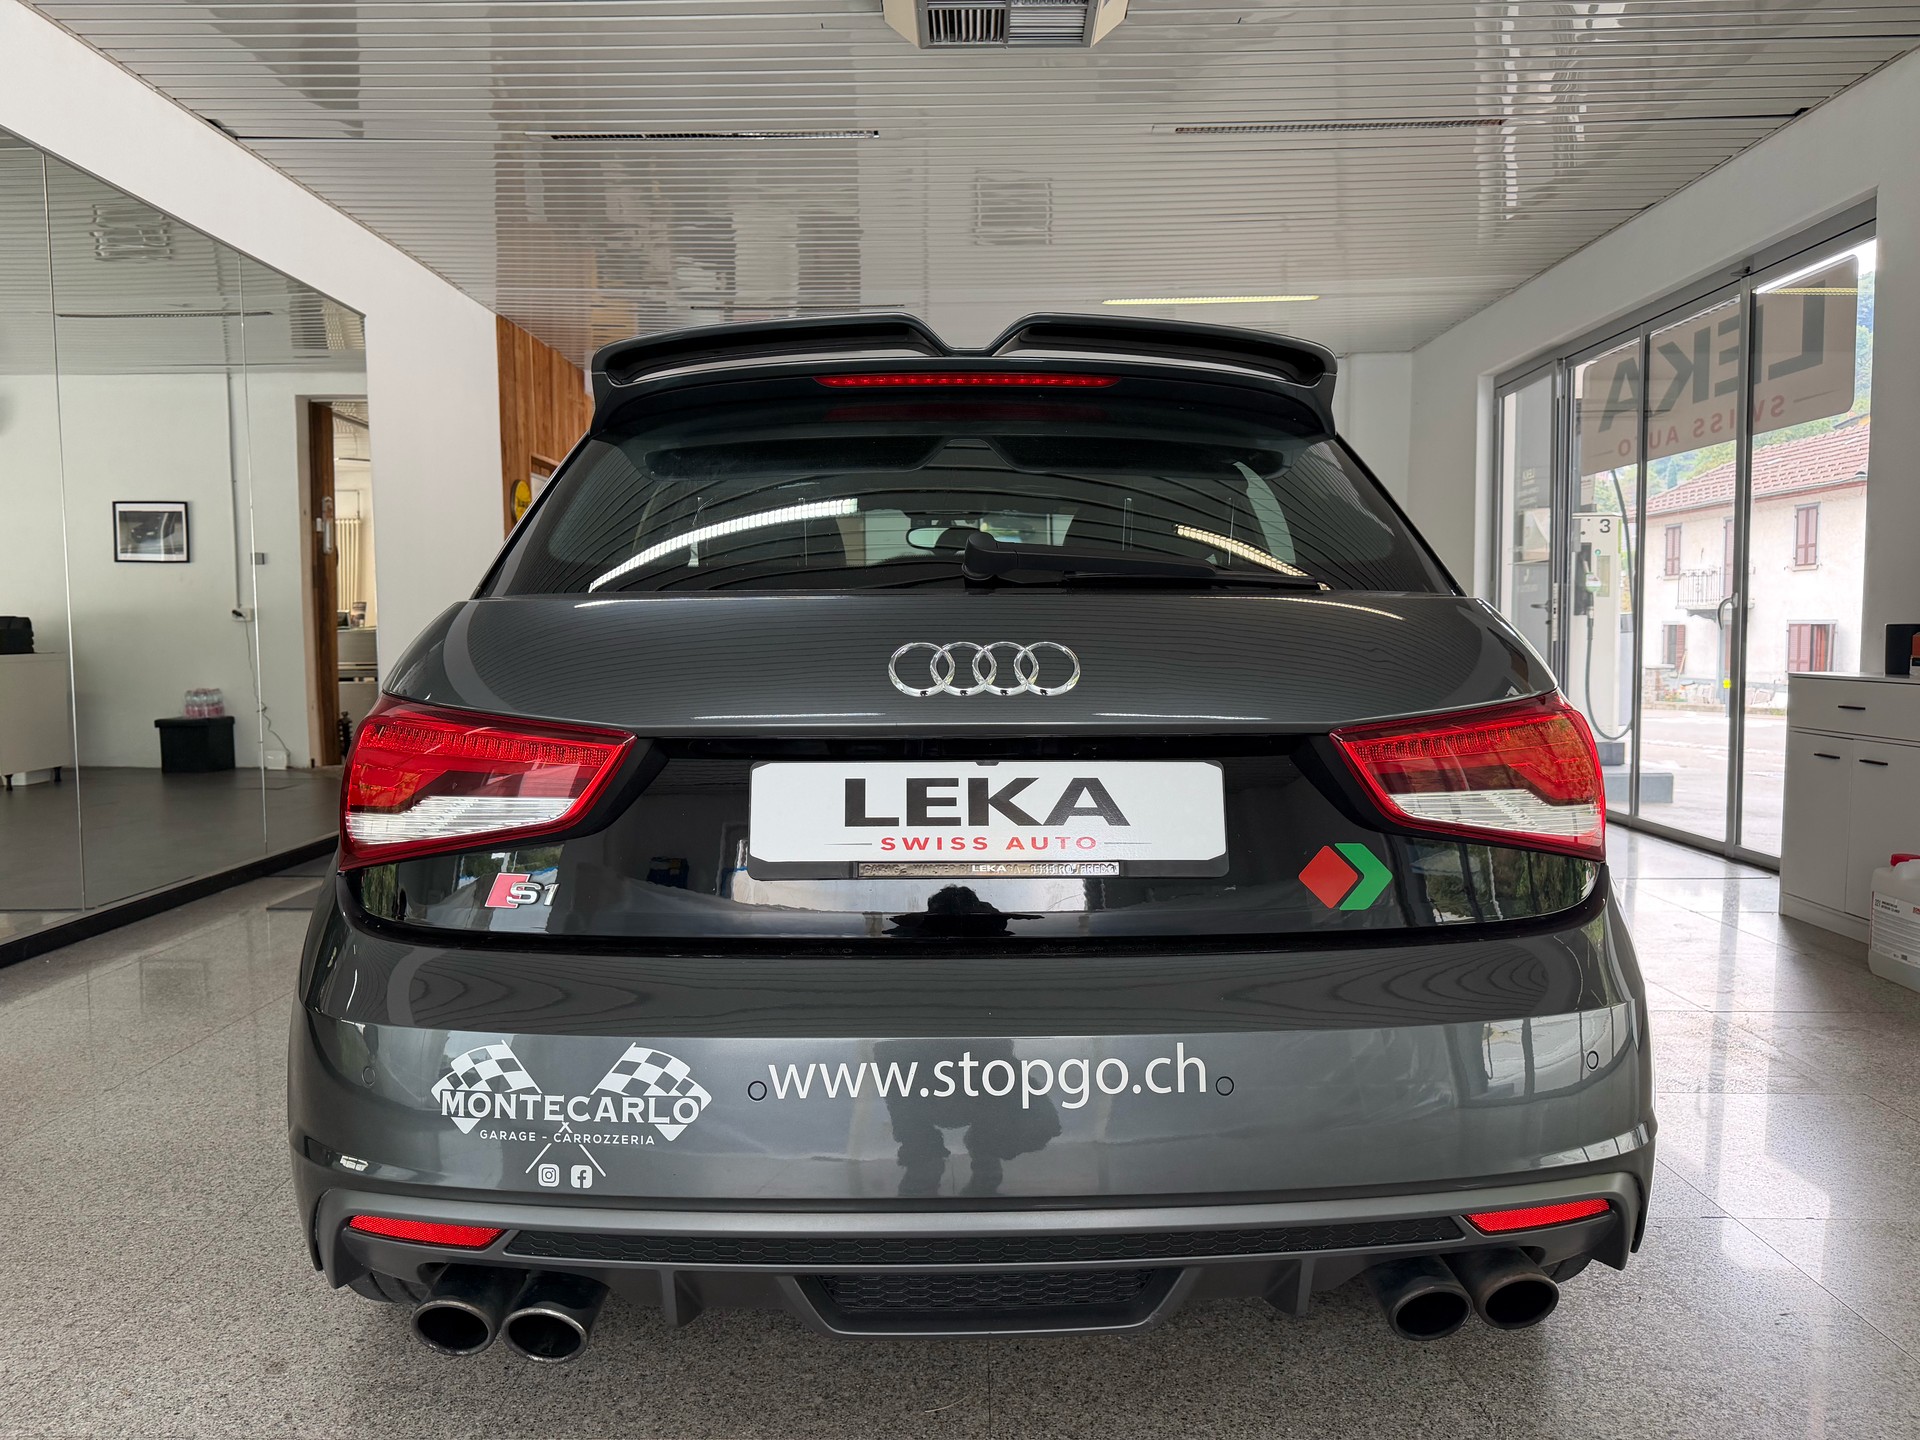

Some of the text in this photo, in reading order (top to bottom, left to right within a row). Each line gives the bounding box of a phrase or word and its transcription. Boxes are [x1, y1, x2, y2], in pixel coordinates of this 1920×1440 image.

[1599, 518, 1611, 534] 3
[844, 777, 1132, 827] LEKA
[880, 836, 1098, 851] SWISS AUTO
[971, 864, 1007, 873] LEKA
[505, 881, 561, 907] S1
[768, 1042, 1208, 1110] www.stopgo.ch
[440, 1089, 701, 1125] MONTECARLO
[479, 1129, 537, 1143] GARAGE
[553, 1132, 656, 1146] CARROZZERIA
